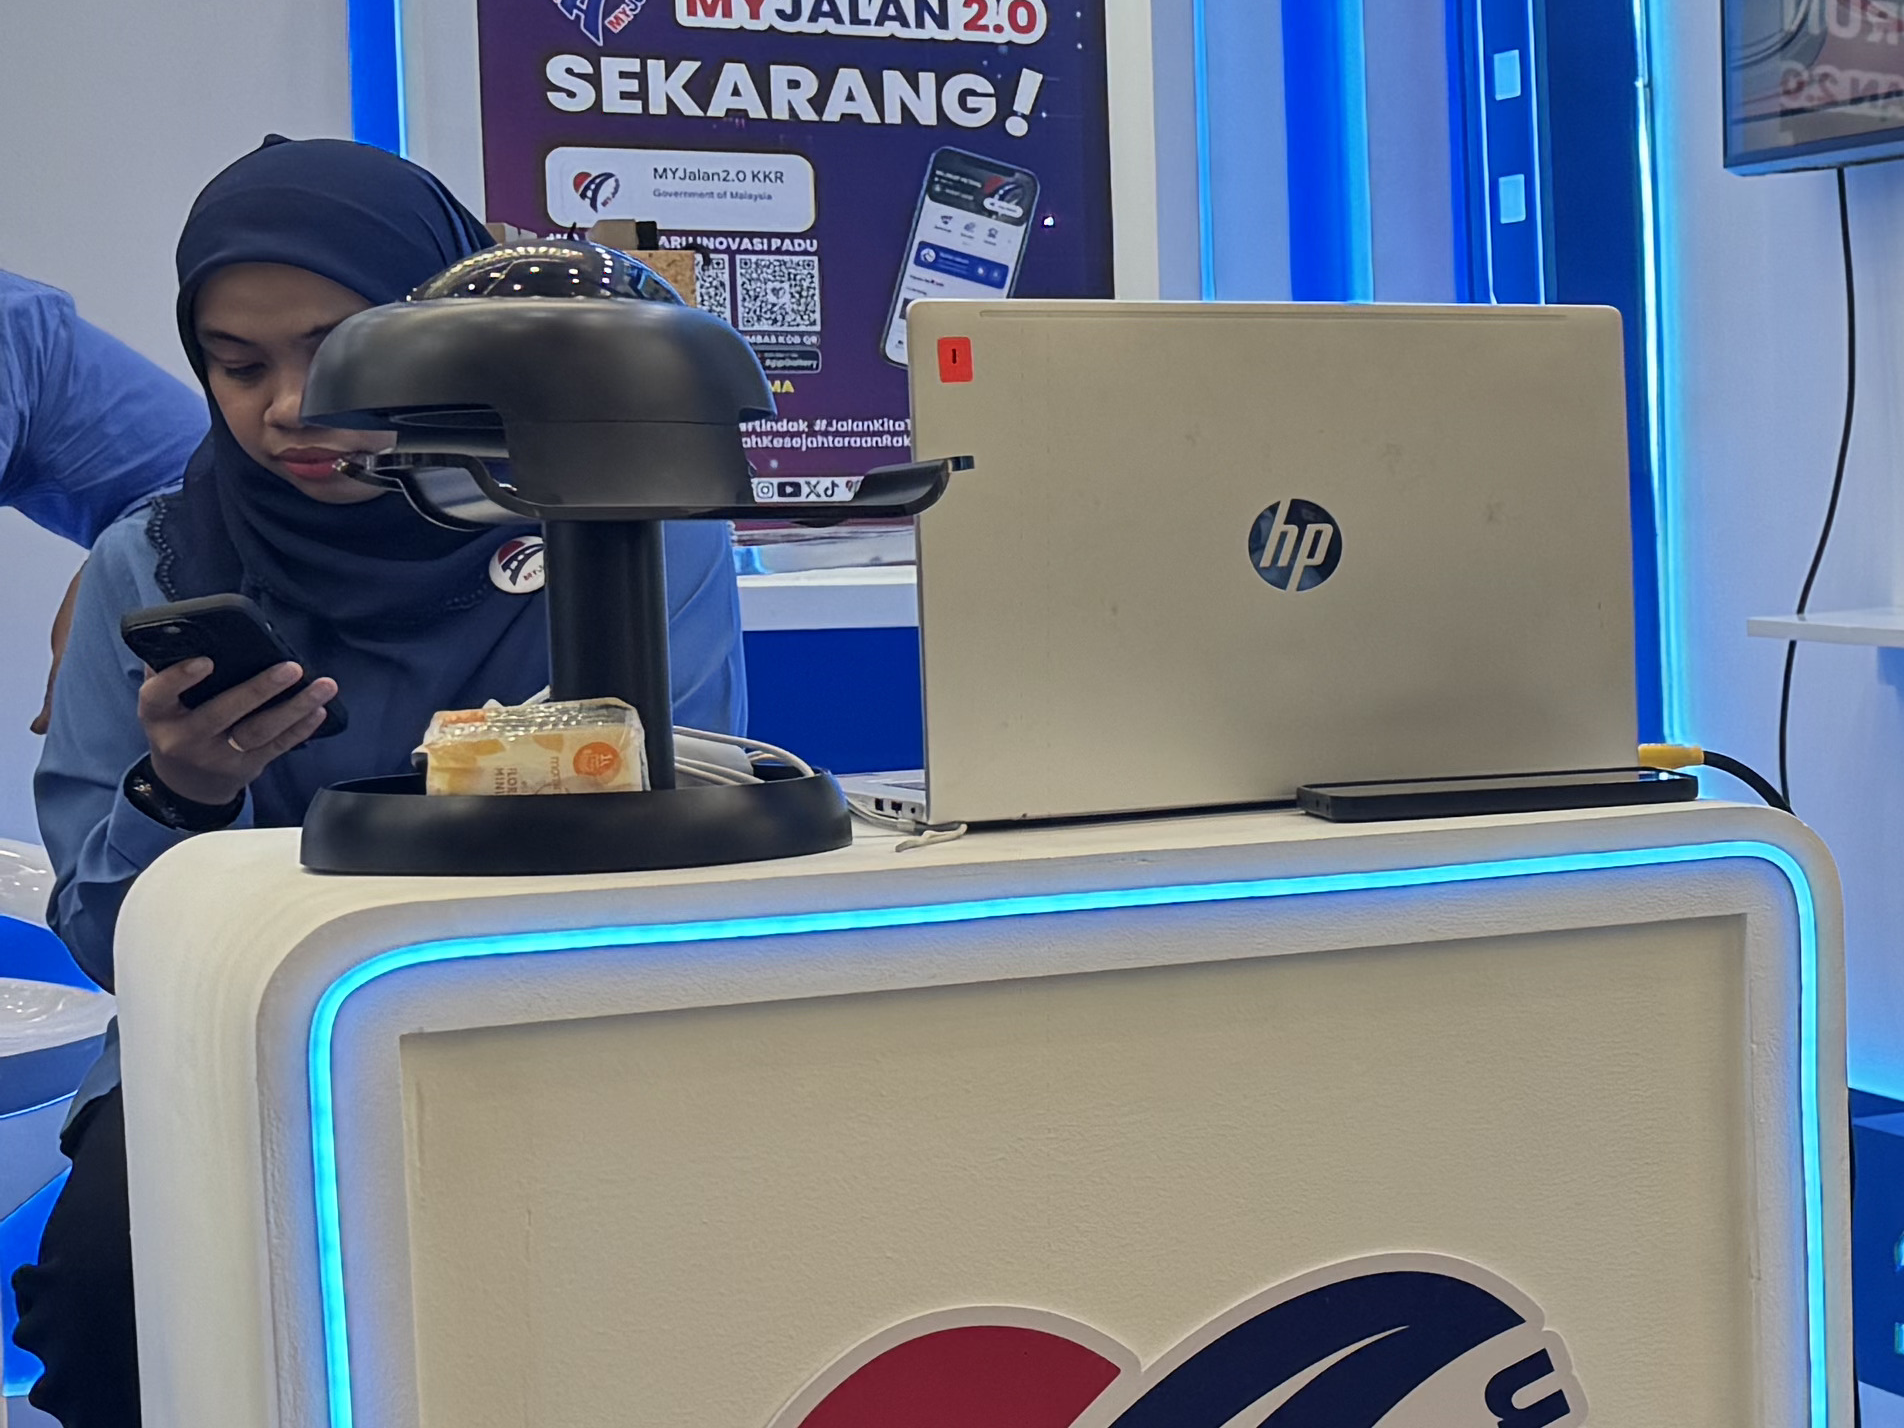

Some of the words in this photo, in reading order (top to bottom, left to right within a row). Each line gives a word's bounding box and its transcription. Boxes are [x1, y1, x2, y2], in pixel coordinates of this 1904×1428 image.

[545, 54, 1044, 137] SEKARANG!
[653, 167, 748, 183] MYJalan2.0
[751, 169, 785, 184] KKR
[653, 188, 715, 199] Government
[717, 189, 728, 199] of
[730, 191, 773, 202] Malaysia
[771, 238, 818, 253] PADU
[1257, 499, 1335, 591] hp
